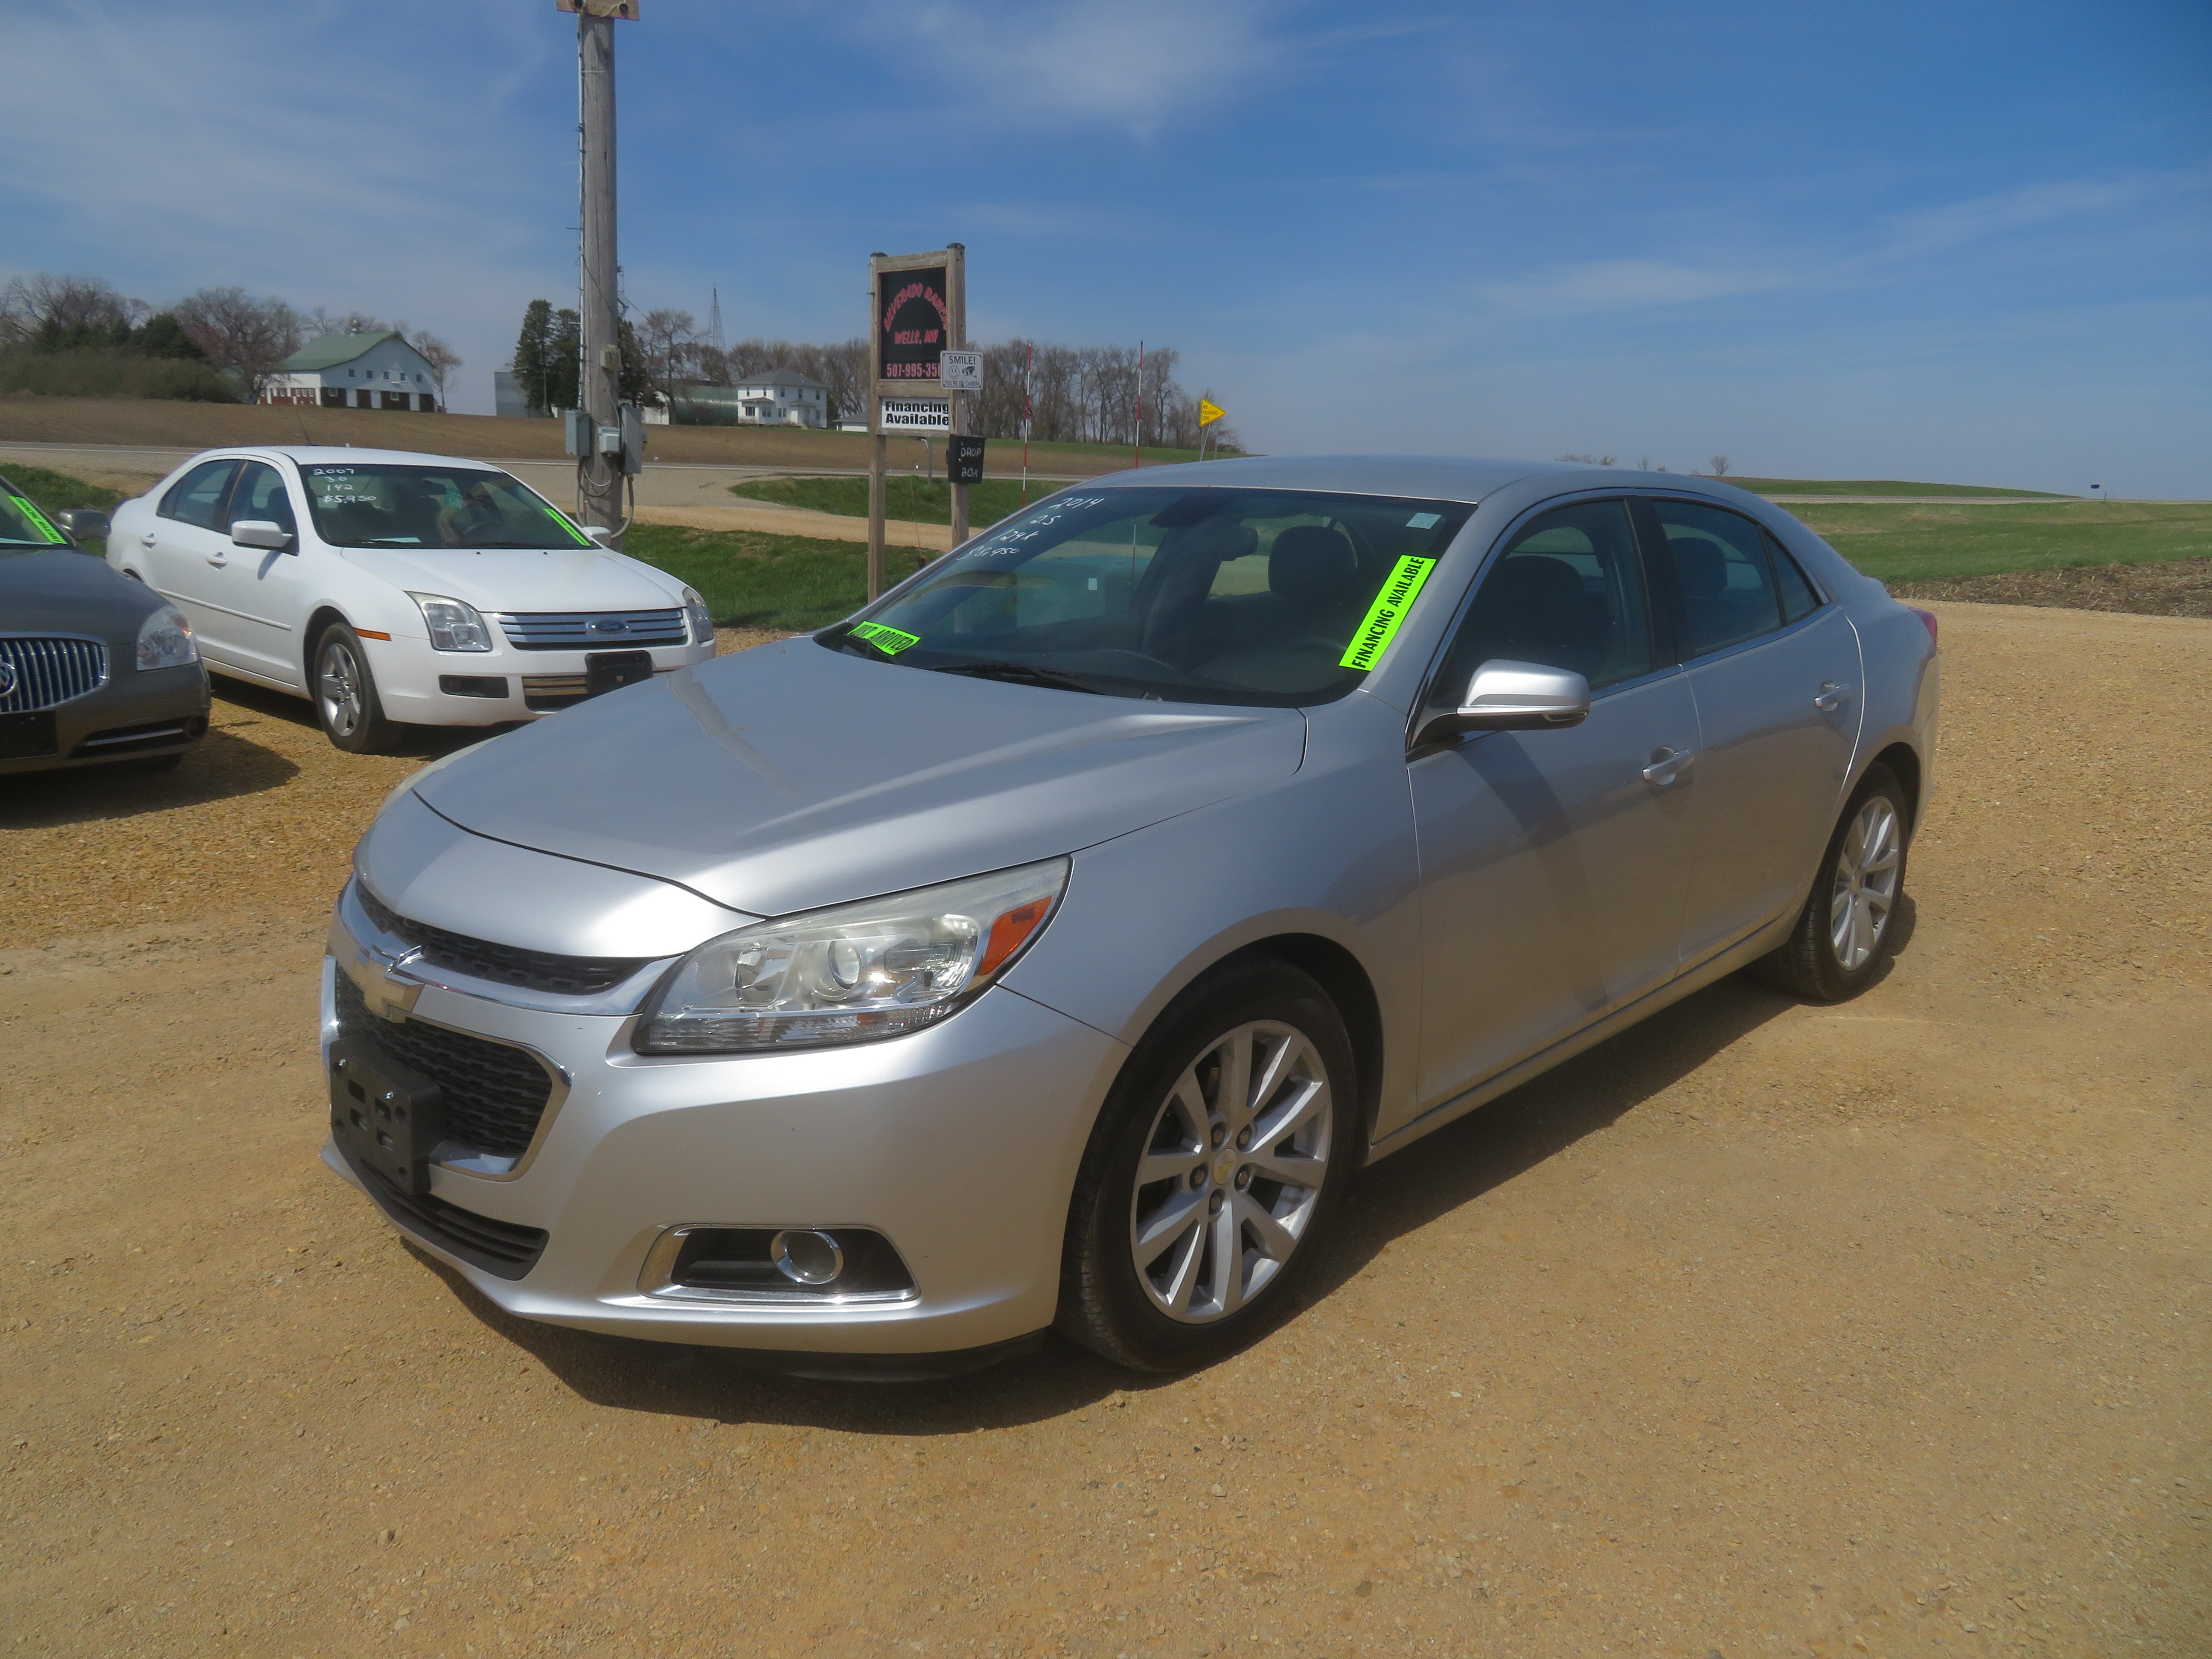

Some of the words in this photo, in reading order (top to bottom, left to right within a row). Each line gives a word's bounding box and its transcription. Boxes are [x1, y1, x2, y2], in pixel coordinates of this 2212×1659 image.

[884, 283, 923, 332] SILVERADO
[894, 330, 922, 344] WELLS,
[924, 329, 939, 343] MN
[949, 355, 975, 365] SMILE!
[885, 401, 949, 414] Financing
[885, 413, 949, 425] Available
[960, 447, 981, 457] DROP
[961, 467, 978, 477] BOX
[1048, 497, 1105, 509] 2014
[1030, 515, 1062, 526] 2.5
[1351, 609, 1395, 669] FINANCING
[1386, 557, 1425, 608] AVAILABLE
